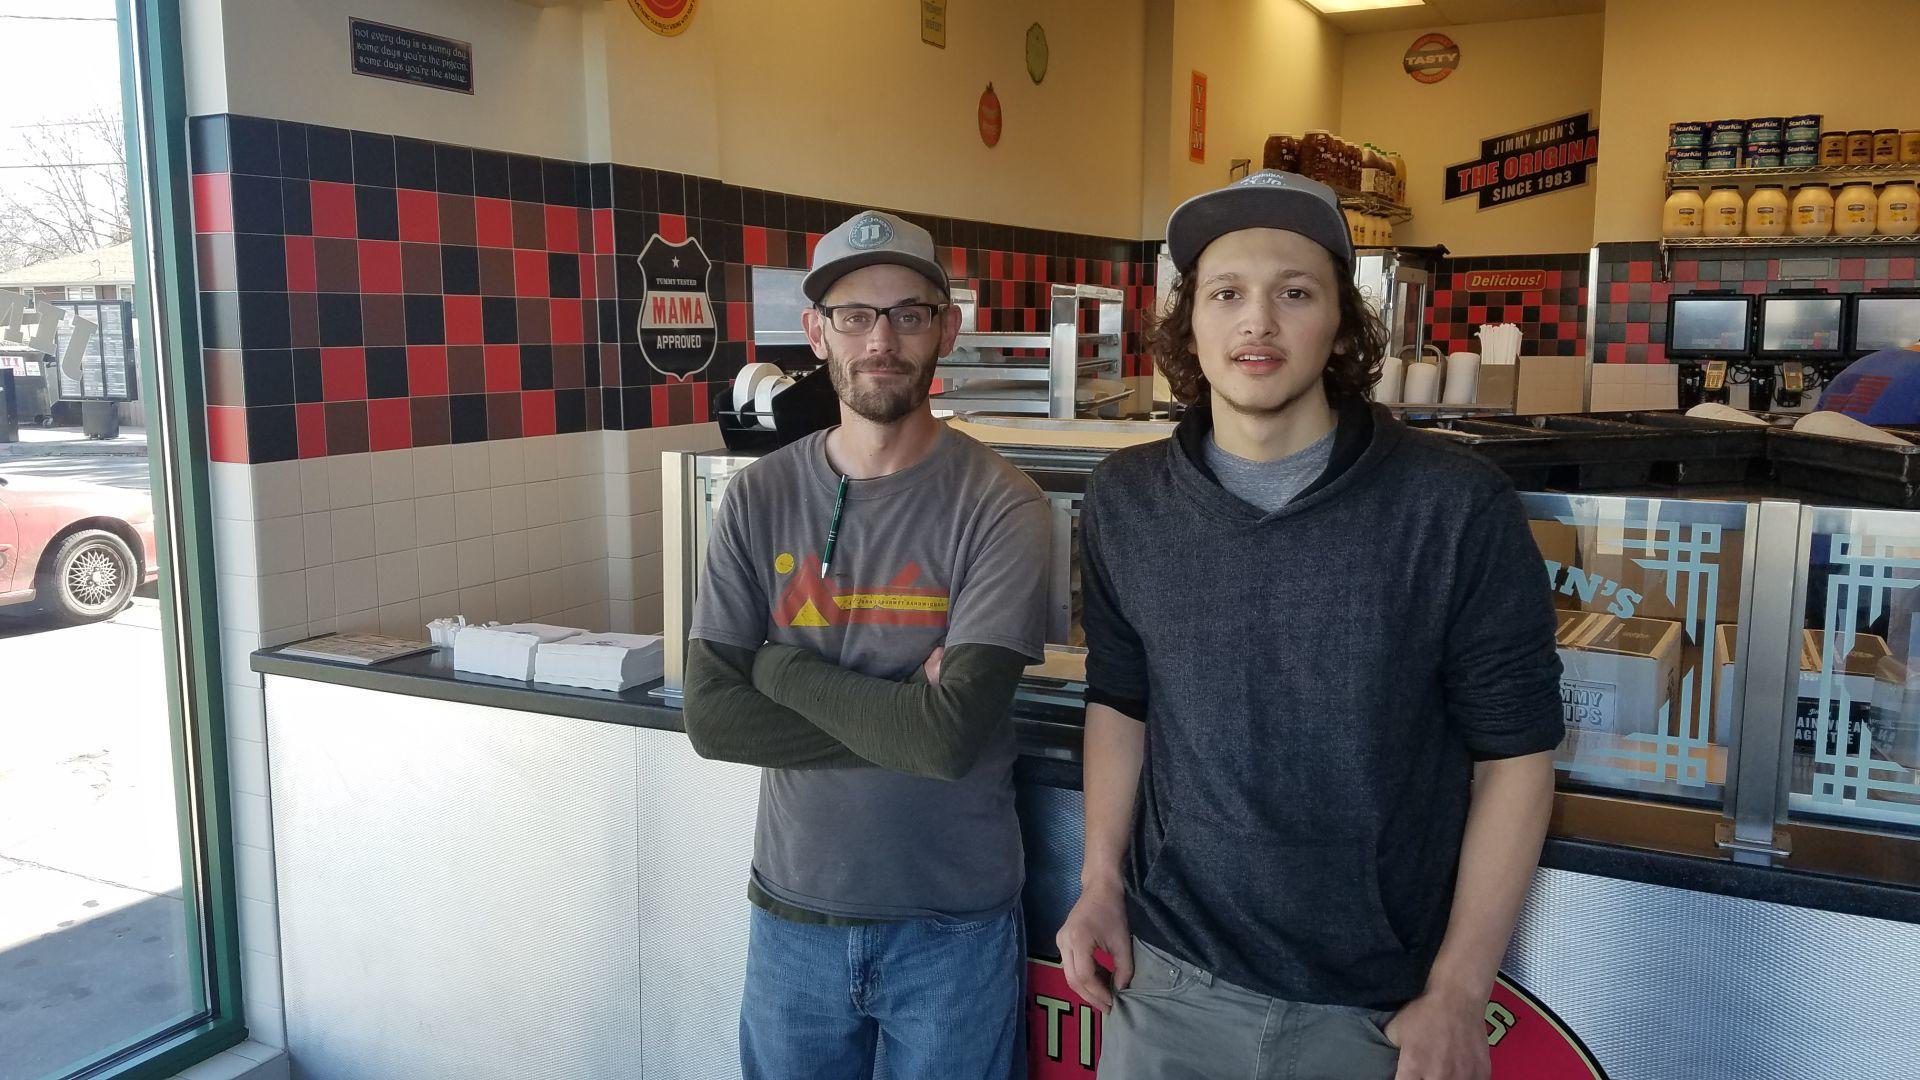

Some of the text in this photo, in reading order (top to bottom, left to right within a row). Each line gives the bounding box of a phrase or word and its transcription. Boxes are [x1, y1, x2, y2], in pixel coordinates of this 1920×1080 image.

[354, 28, 369, 38] not
[371, 32, 394, 44] every
[396, 36, 410, 48] day
[413, 38, 419, 48] is
[422, 42, 426, 50] a
[428, 44, 451, 54] sunny
[356, 42, 380, 53] some
[381, 46, 400, 58] days
[402, 51, 428, 63] you're
[428, 54, 440, 66] the
[1405, 53, 1458, 65] TASTY
[358, 56, 382, 66] some
[384, 59, 403, 72] days
[405, 64, 429, 75] you're
[430, 68, 442, 78] the
[1494, 122, 1575, 155] JIMMY JOHN'S
[1458, 136, 1599, 192] THE ORIGINA
[1492, 170, 1572, 201] SINCE 1983
[656, 277, 698, 286] TUMMY TESTED
[1471, 274, 1542, 286] Delicious!
[652, 296, 704, 325] MAMA
[656, 334, 702, 350] APPROVED
[1560, 689, 1603, 707] MMY
[1566, 705, 1602, 725] IPS
